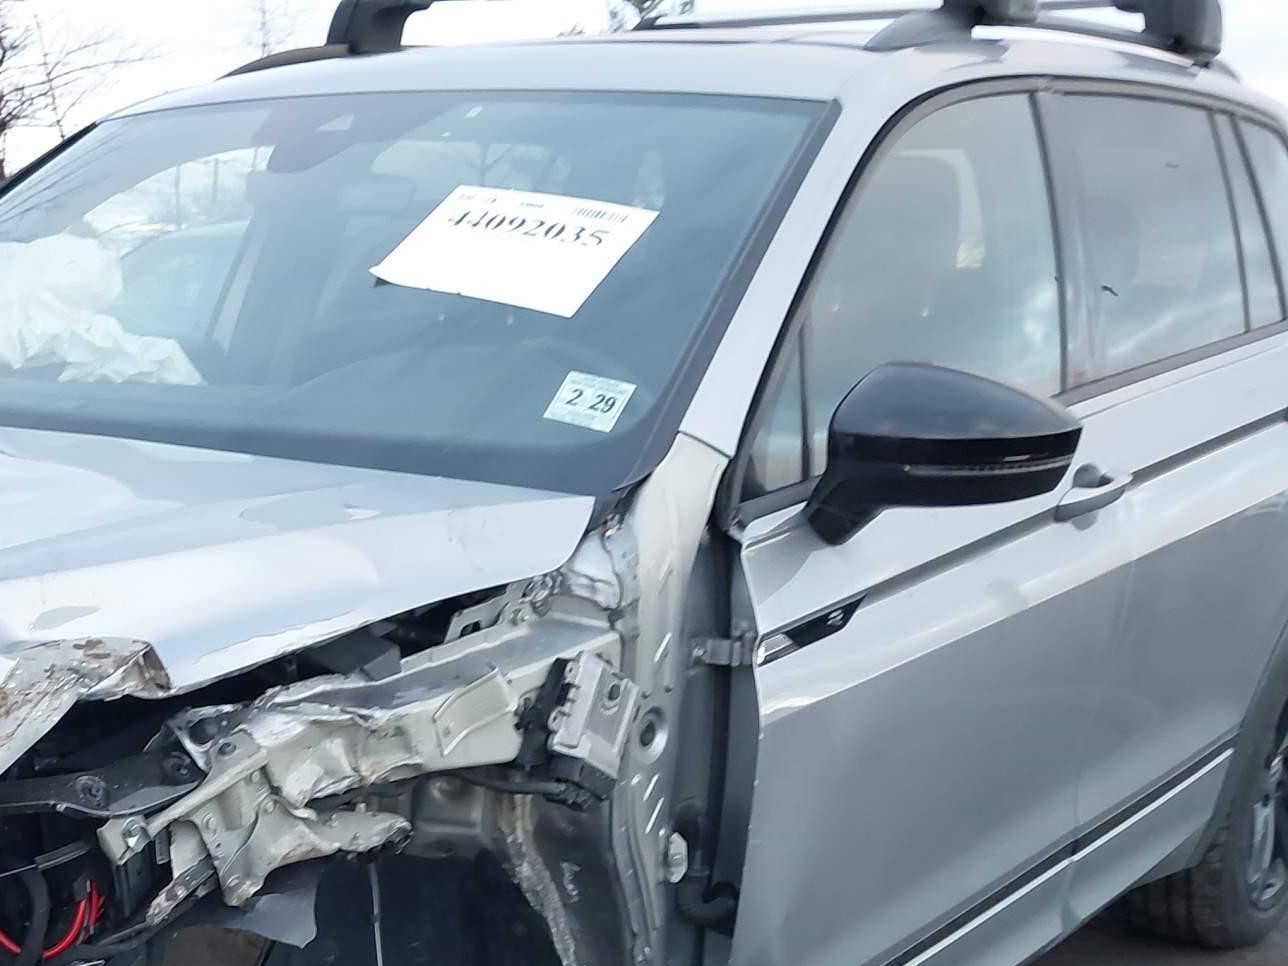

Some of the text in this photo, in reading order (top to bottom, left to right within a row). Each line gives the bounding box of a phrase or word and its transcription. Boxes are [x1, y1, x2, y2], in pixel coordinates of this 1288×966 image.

[448, 210, 610, 246] 44092035
[565, 388, 617, 414] 2 29
